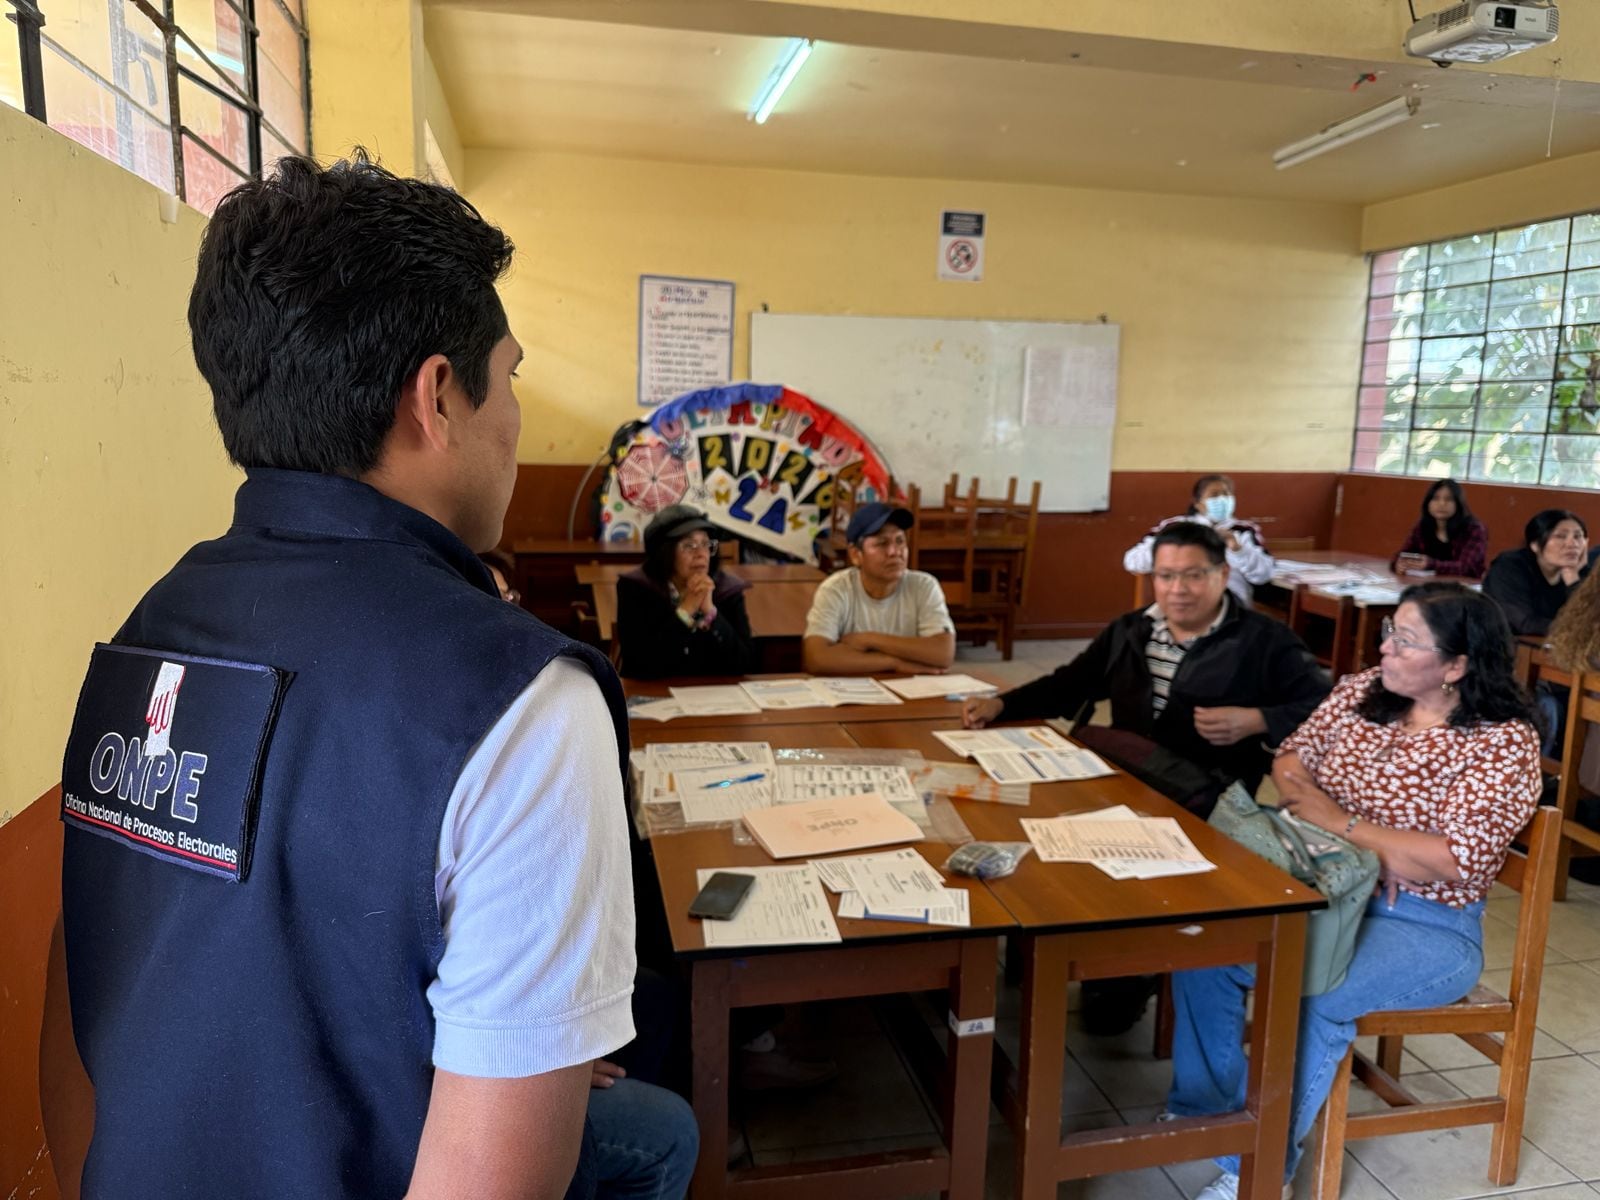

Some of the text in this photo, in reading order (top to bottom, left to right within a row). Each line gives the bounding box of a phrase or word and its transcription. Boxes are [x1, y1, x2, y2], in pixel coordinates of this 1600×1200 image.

[729, 477, 787, 535] 2A
[89, 732, 208, 824] ONPE
[65, 792, 237, 863] Oficina Nacional de Procesos Electorales
